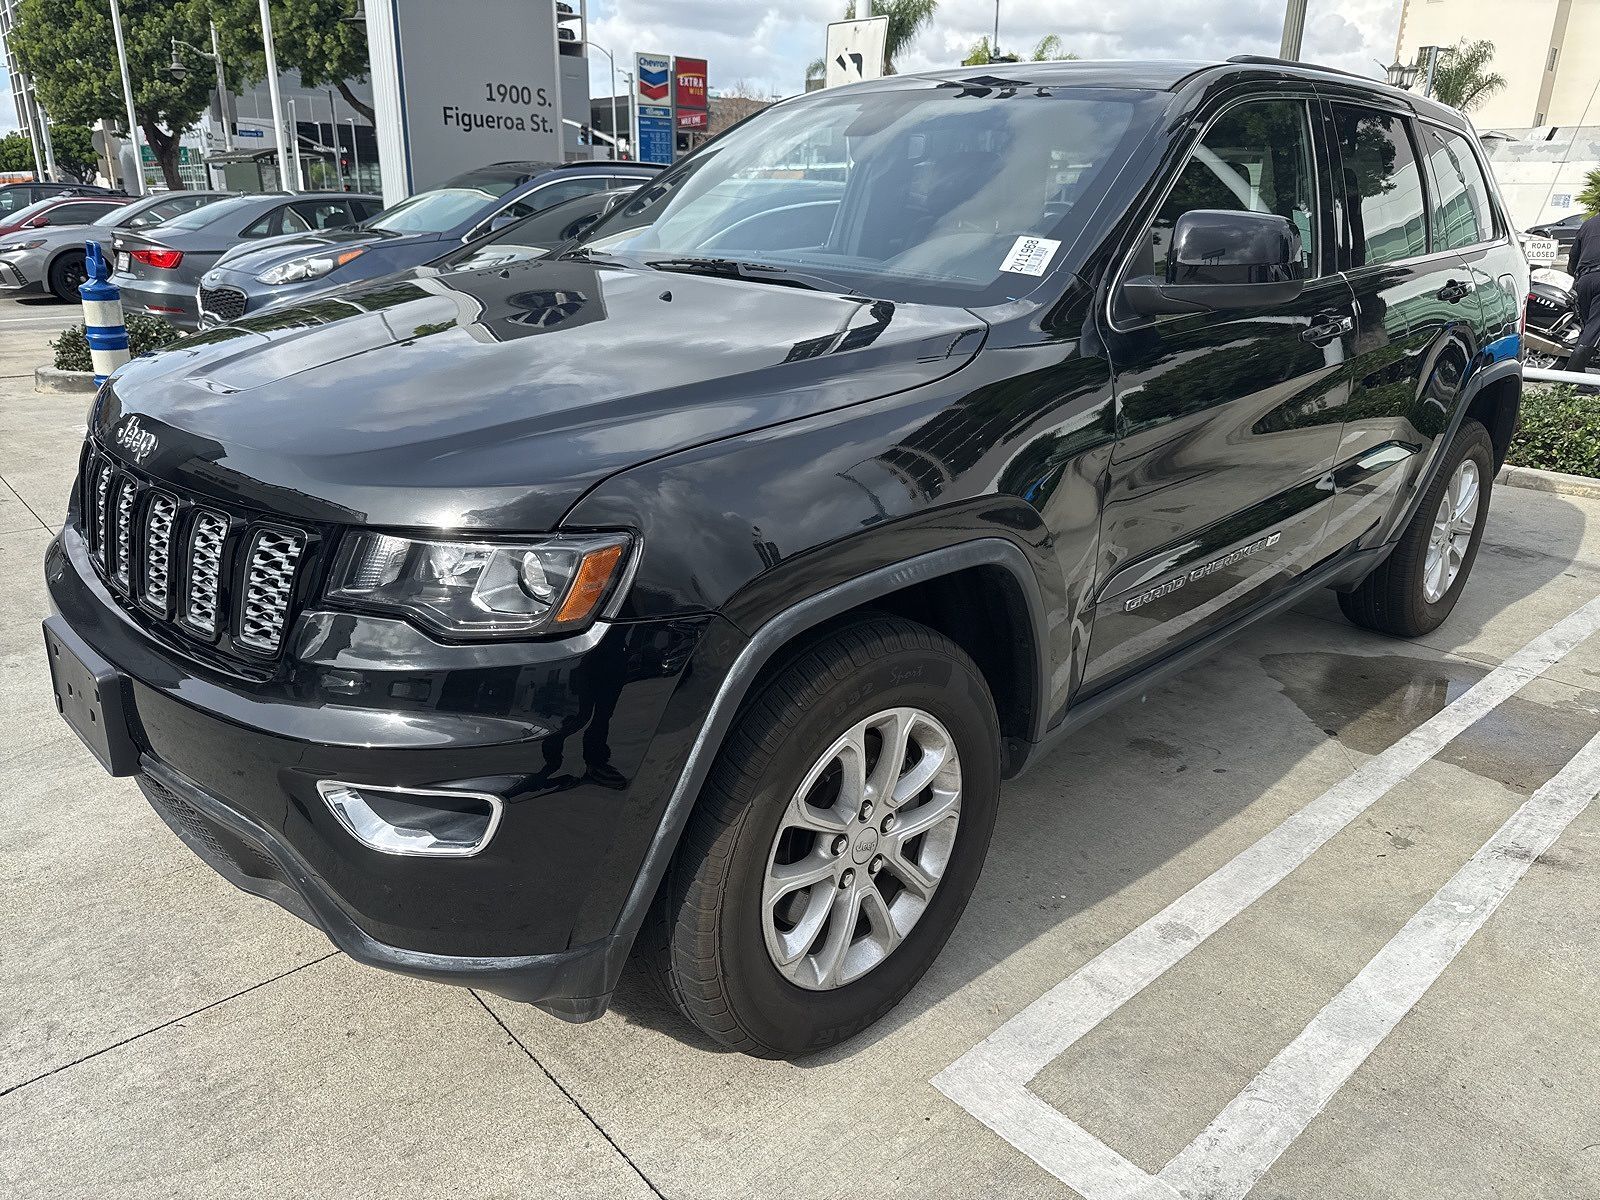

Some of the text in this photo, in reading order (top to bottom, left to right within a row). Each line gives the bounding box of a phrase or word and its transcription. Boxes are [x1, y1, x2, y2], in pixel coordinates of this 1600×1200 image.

[639, 57, 669, 68] Chevron
[680, 77, 704, 89] EXTRA
[485, 83, 552, 108] 1900 S.
[442, 106, 553, 134] Figueroa St.
[1531, 242, 1552, 250] ROAD
[1009, 239, 1039, 272] ZV11968
[1536, 297, 1556, 308] LAPD
[115, 415, 159, 464] Jeep
[1123, 531, 1282, 612] GRAND CHEROKEE
[855, 841, 876, 853] Jeep
